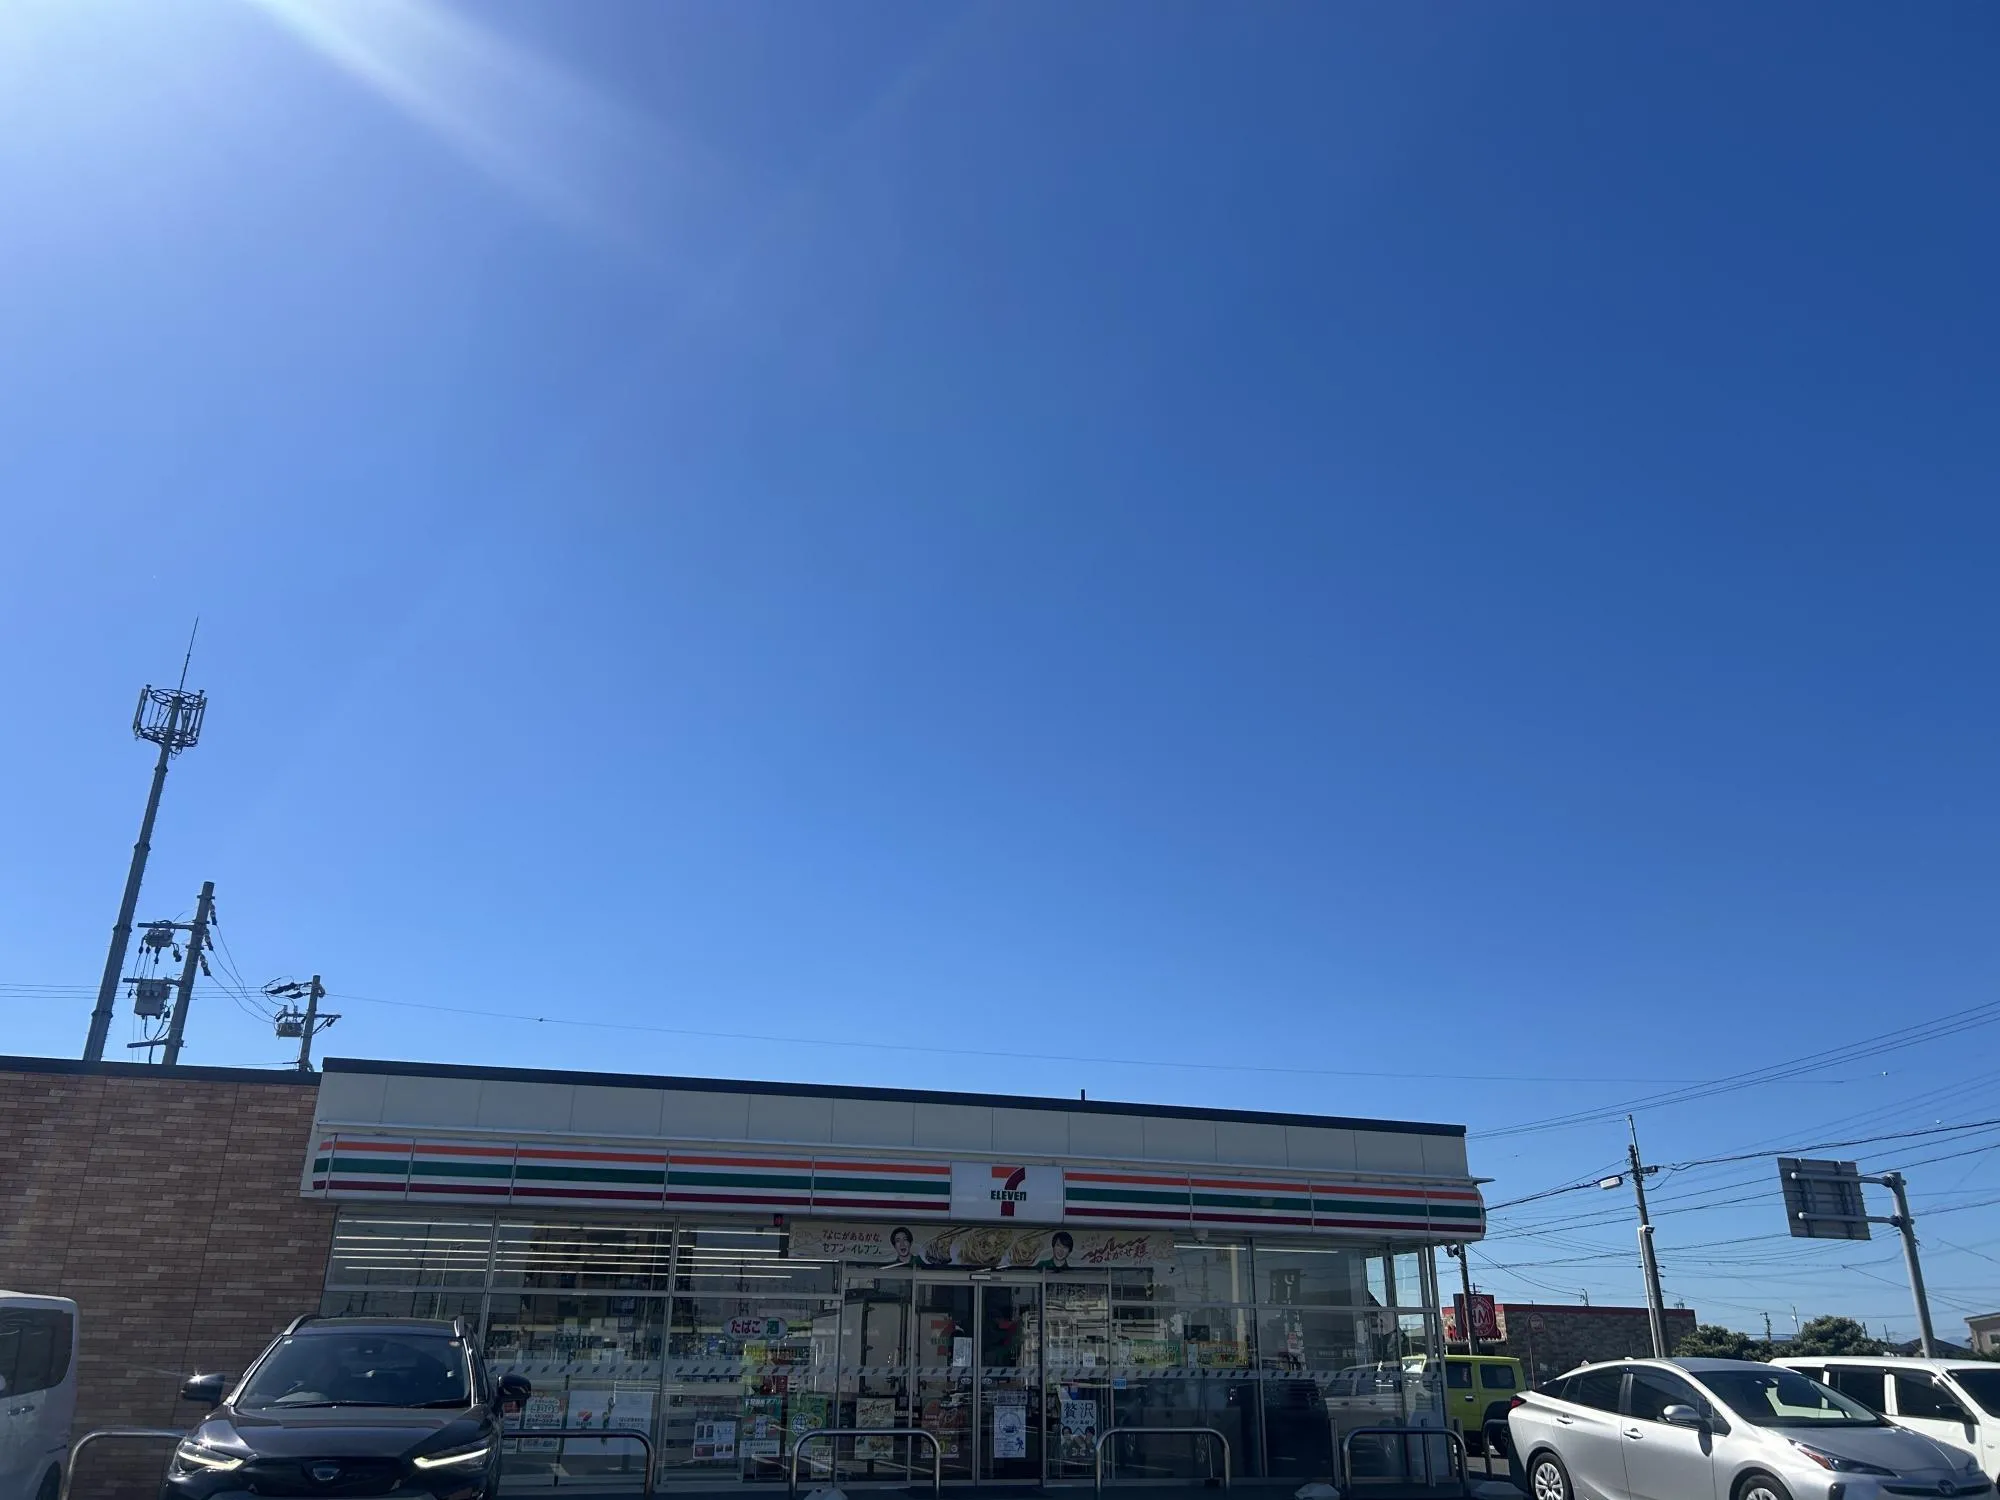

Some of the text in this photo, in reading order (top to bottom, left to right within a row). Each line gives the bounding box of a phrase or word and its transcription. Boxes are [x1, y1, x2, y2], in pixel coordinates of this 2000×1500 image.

[731, 1319, 761, 1334] たばこ
[1064, 1401, 1094, 1419] 贅沢
